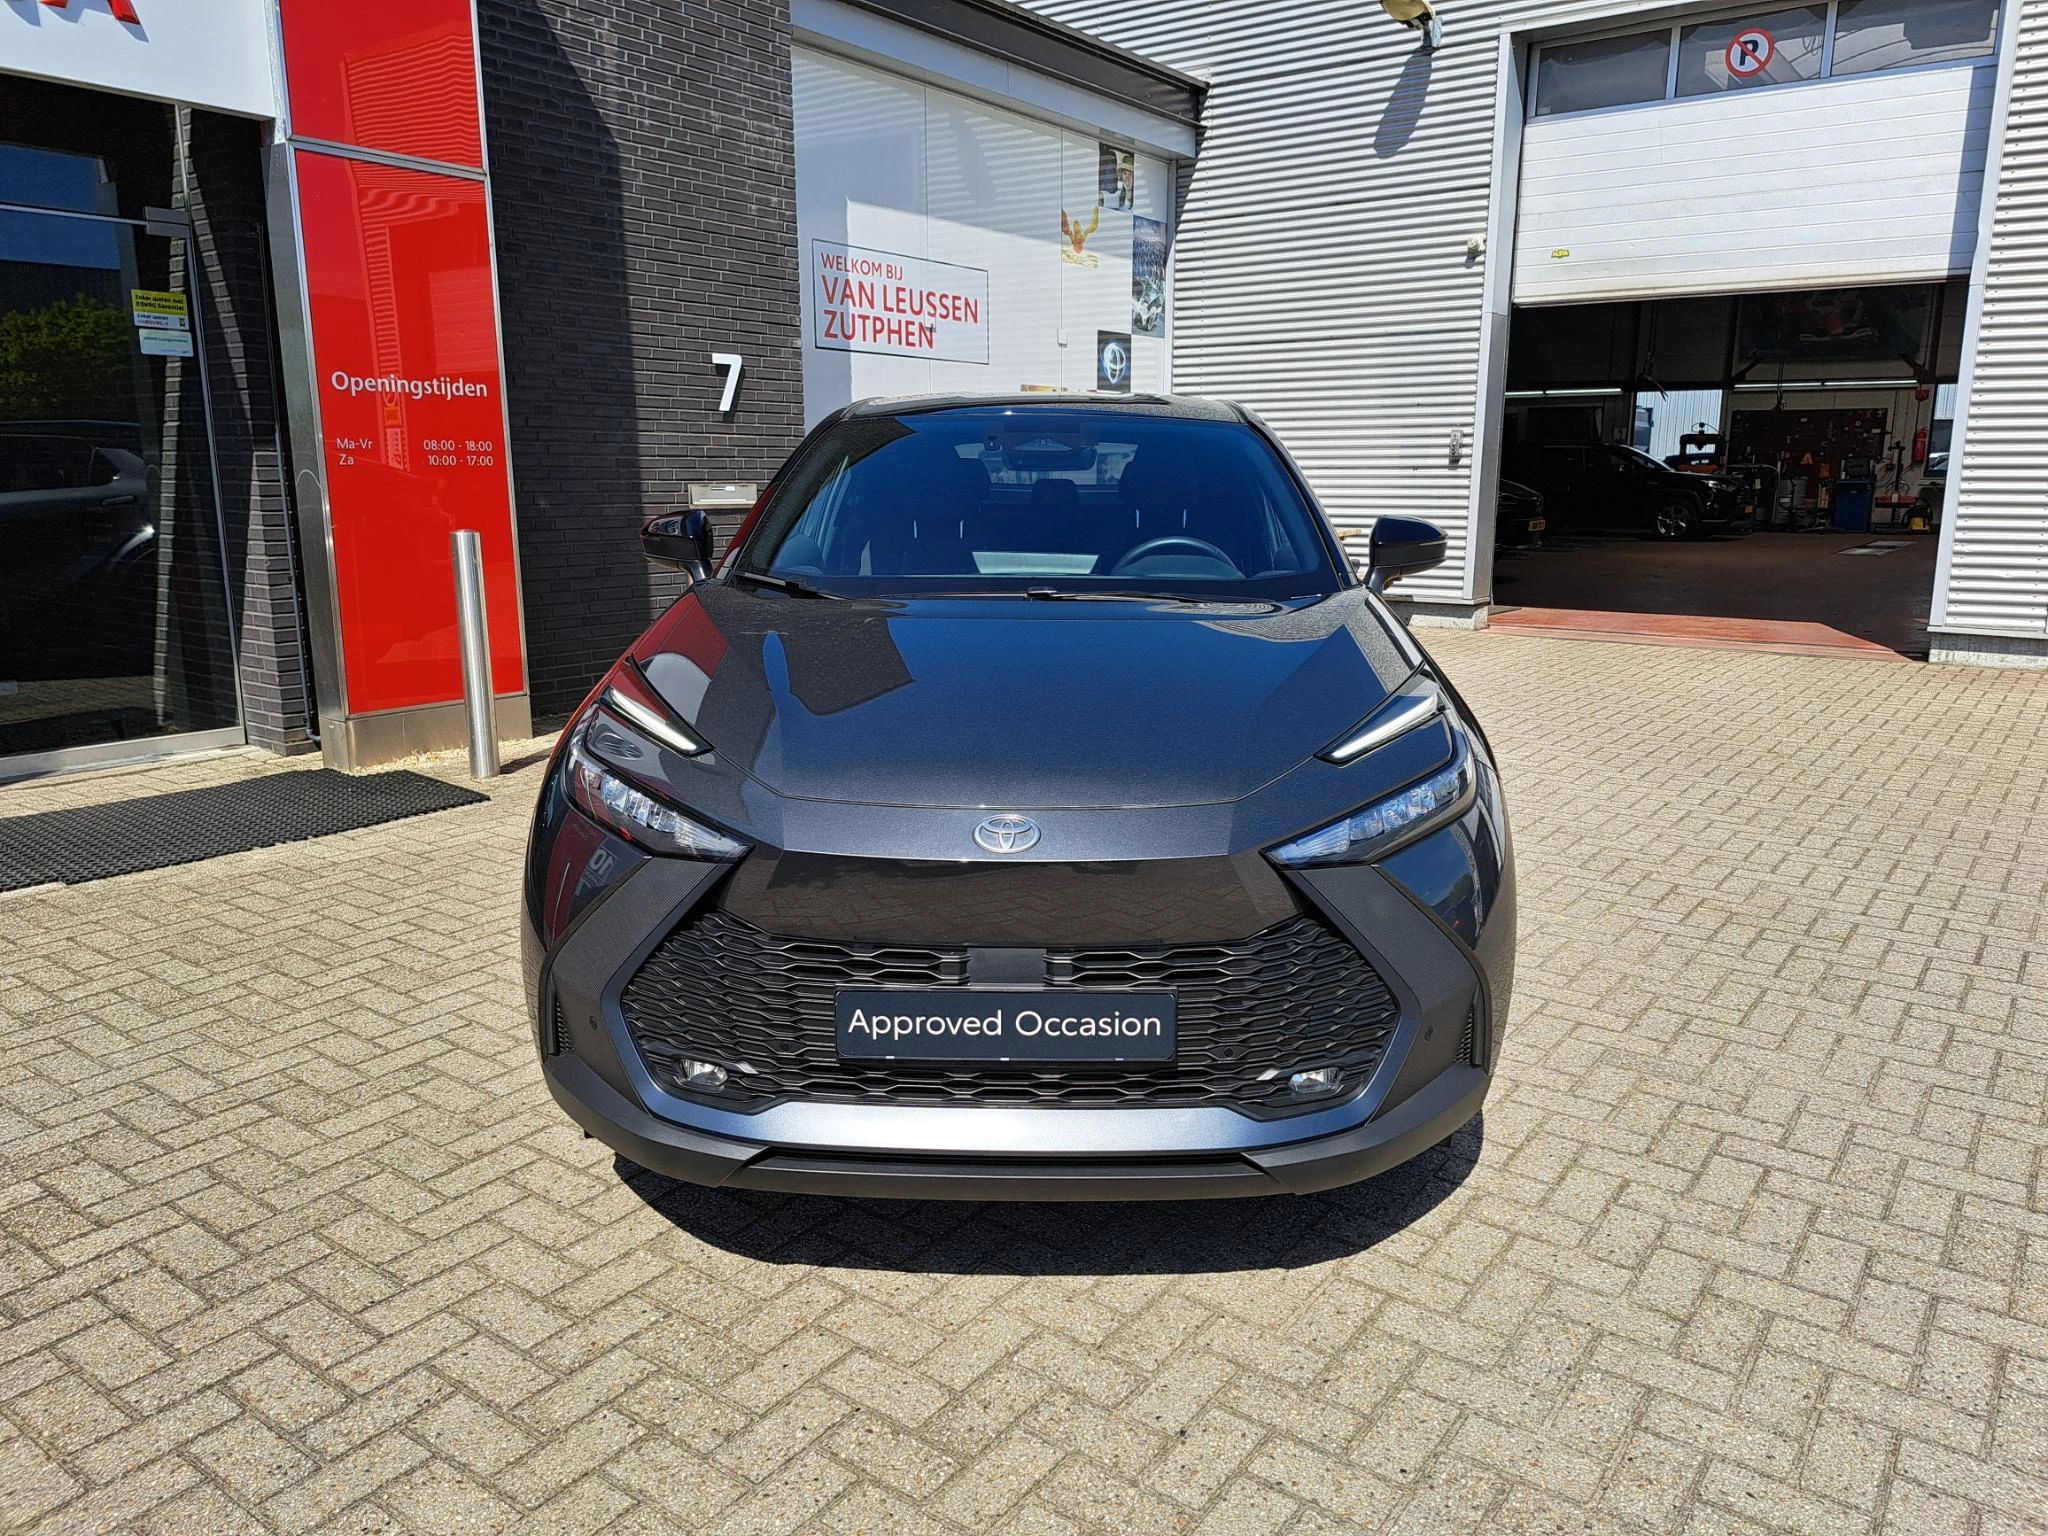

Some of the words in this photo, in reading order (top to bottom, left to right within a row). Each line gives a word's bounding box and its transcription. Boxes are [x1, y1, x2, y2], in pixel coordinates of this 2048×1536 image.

[820, 252, 883, 278] WELKOM
[886, 264, 903, 281] BIJ
[821, 274, 875, 310] VAN
[882, 284, 979, 324] LEUSSEN
[823, 309, 935, 349] ZUTPHEN
[331, 371, 488, 400] Openingstijden
[711, 352, 742, 411] 7
[336, 438, 373, 450] Ma-Vr
[423, 439, 455, 451] 08:00
[465, 440, 493, 452] 18:00
[339, 453, 355, 465] Za
[428, 455, 457, 466] 10:00
[466, 455, 494, 466] 17:00
[847, 1008, 1003, 1041] Approved
[1015, 1010, 1161, 1037] Occasion
